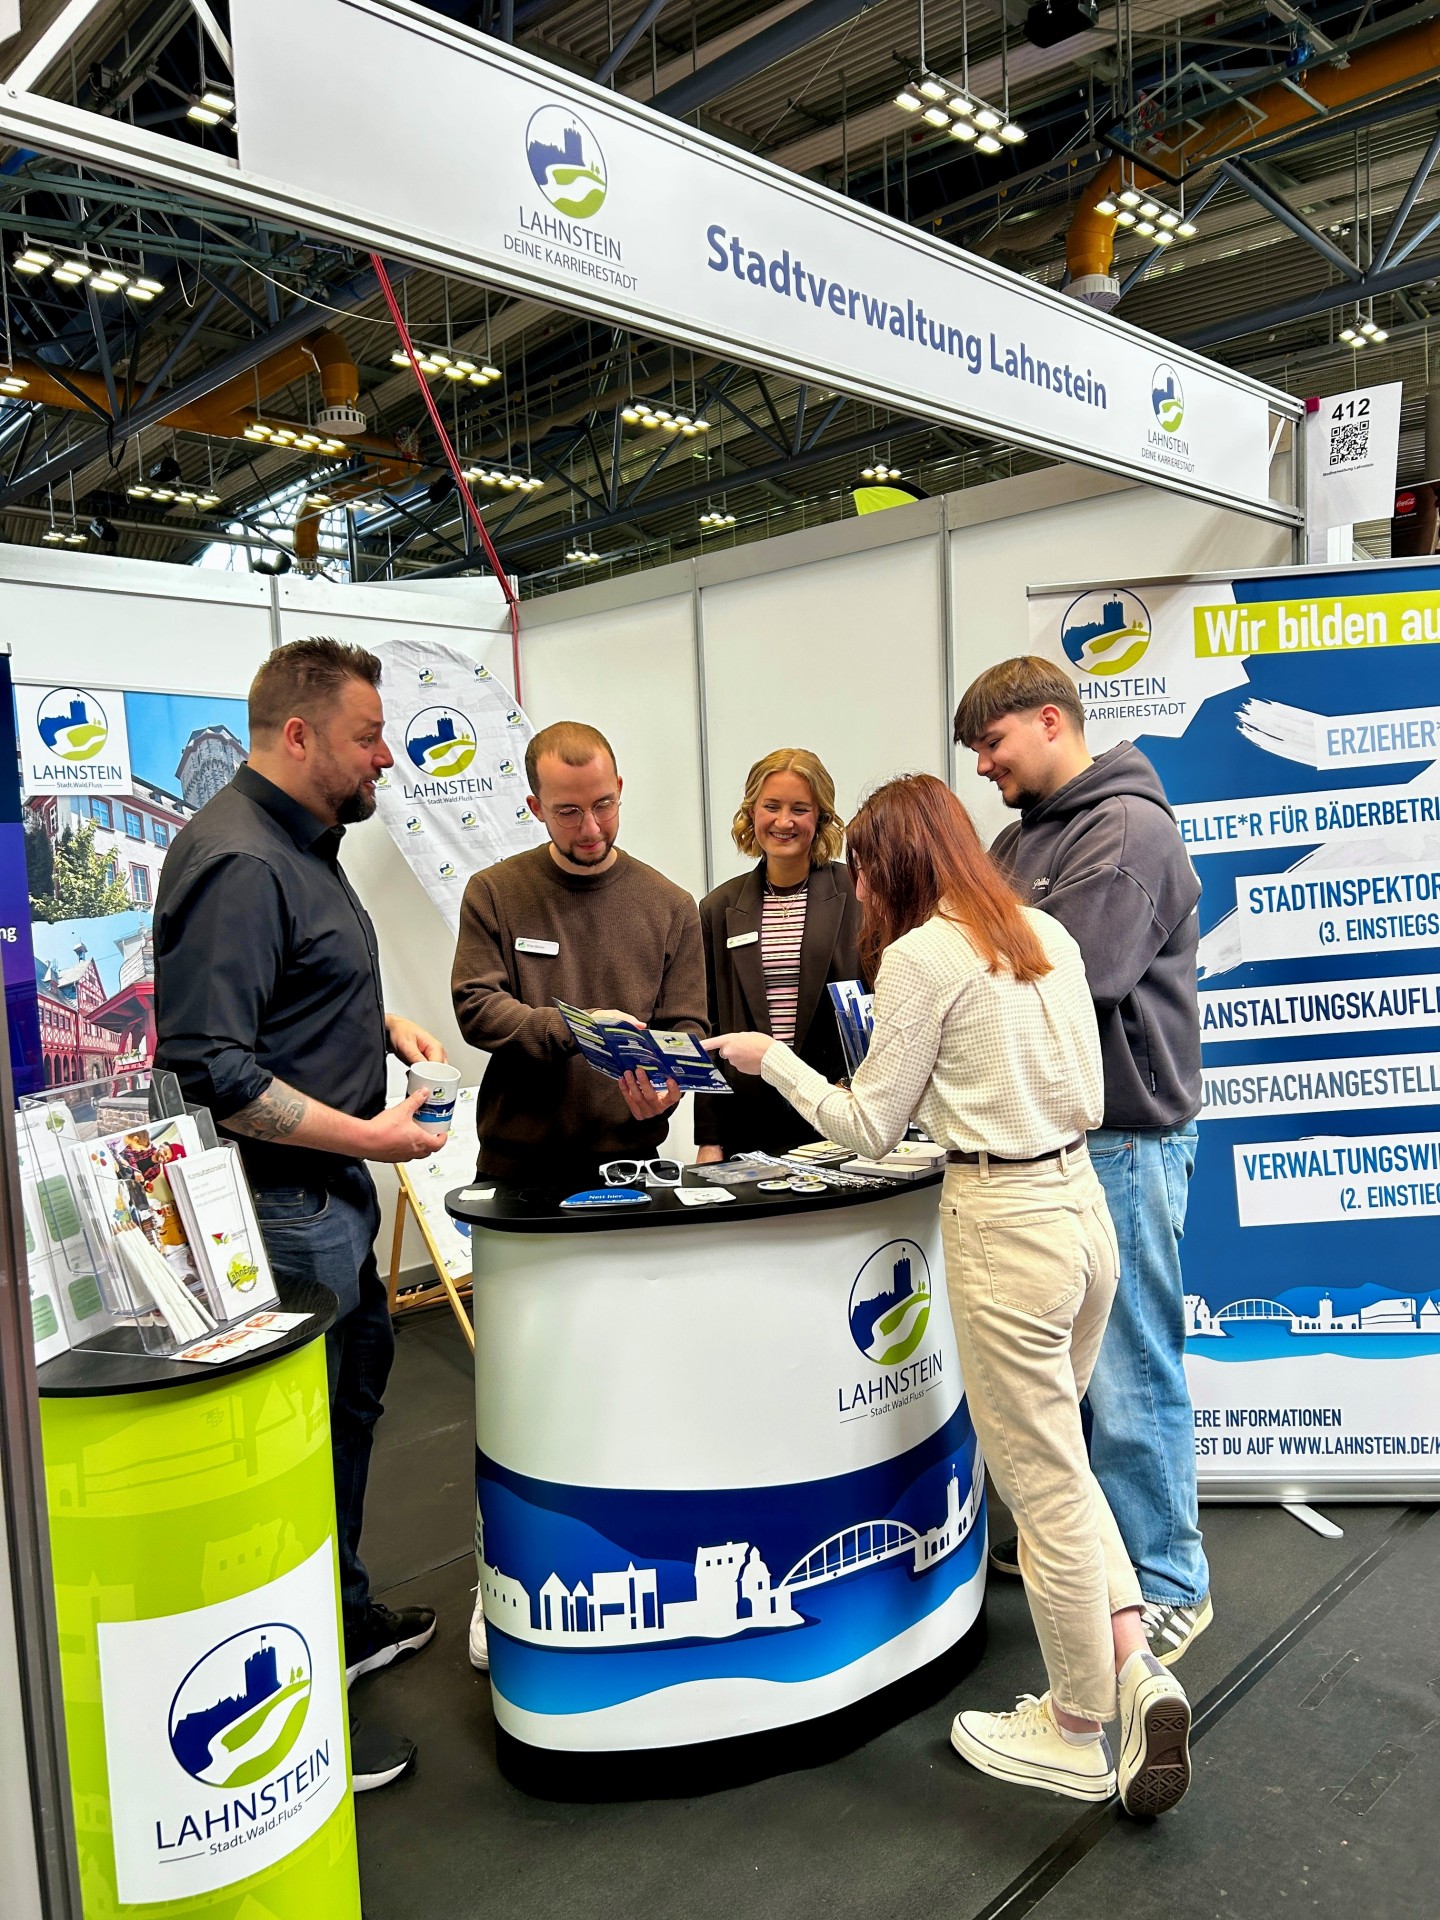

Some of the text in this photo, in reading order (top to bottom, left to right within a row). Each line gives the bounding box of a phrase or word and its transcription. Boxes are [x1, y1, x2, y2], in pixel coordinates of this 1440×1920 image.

[519, 205, 622, 262] LAHNSTEIN
[503, 233, 638, 291] DEINE KARRIERESTADT
[706, 224, 1108, 410] Stadtverwaltung Lahnstein
[1331, 397, 1371, 421] 412
[1141, 447, 1157, 462] DEINE
[1147, 429, 1189, 456] LAHNSTEIN
[1204, 602, 1440, 655] Wir bilden au
[33, 764, 123, 780] LAHNSTEIN
[404, 777, 494, 799] LAHNSTEIN
[427, 795, 473, 805] Stadt.Wald.Fluss
[1177, 813, 1264, 843] ELLTER
[1270, 805, 1309, 834] FÜR
[1249, 872, 1440, 915] STADTINSPEKTOR
[1318, 912, 1440, 946] (3. EINSTIEGS
[1200, 986, 1440, 1030] ANSTALTUNGSKAUFL
[1243, 1142, 1440, 1181] VERWALTUNGSWI
[1340, 1187, 1363, 1213] (2.
[838, 1349, 943, 1412] LAHNSTEIN
[870, 1389, 925, 1418] Stadt.Wald.Fluss
[1225, 1408, 1342, 1428] INFORMATIONEN
[1223, 1437, 1241, 1455] DU
[1246, 1436, 1274, 1455] AUF
[155, 1739, 330, 1850] LAHNSTEIN
[209, 1801, 303, 1856] Stadt.Wald.Fluss
